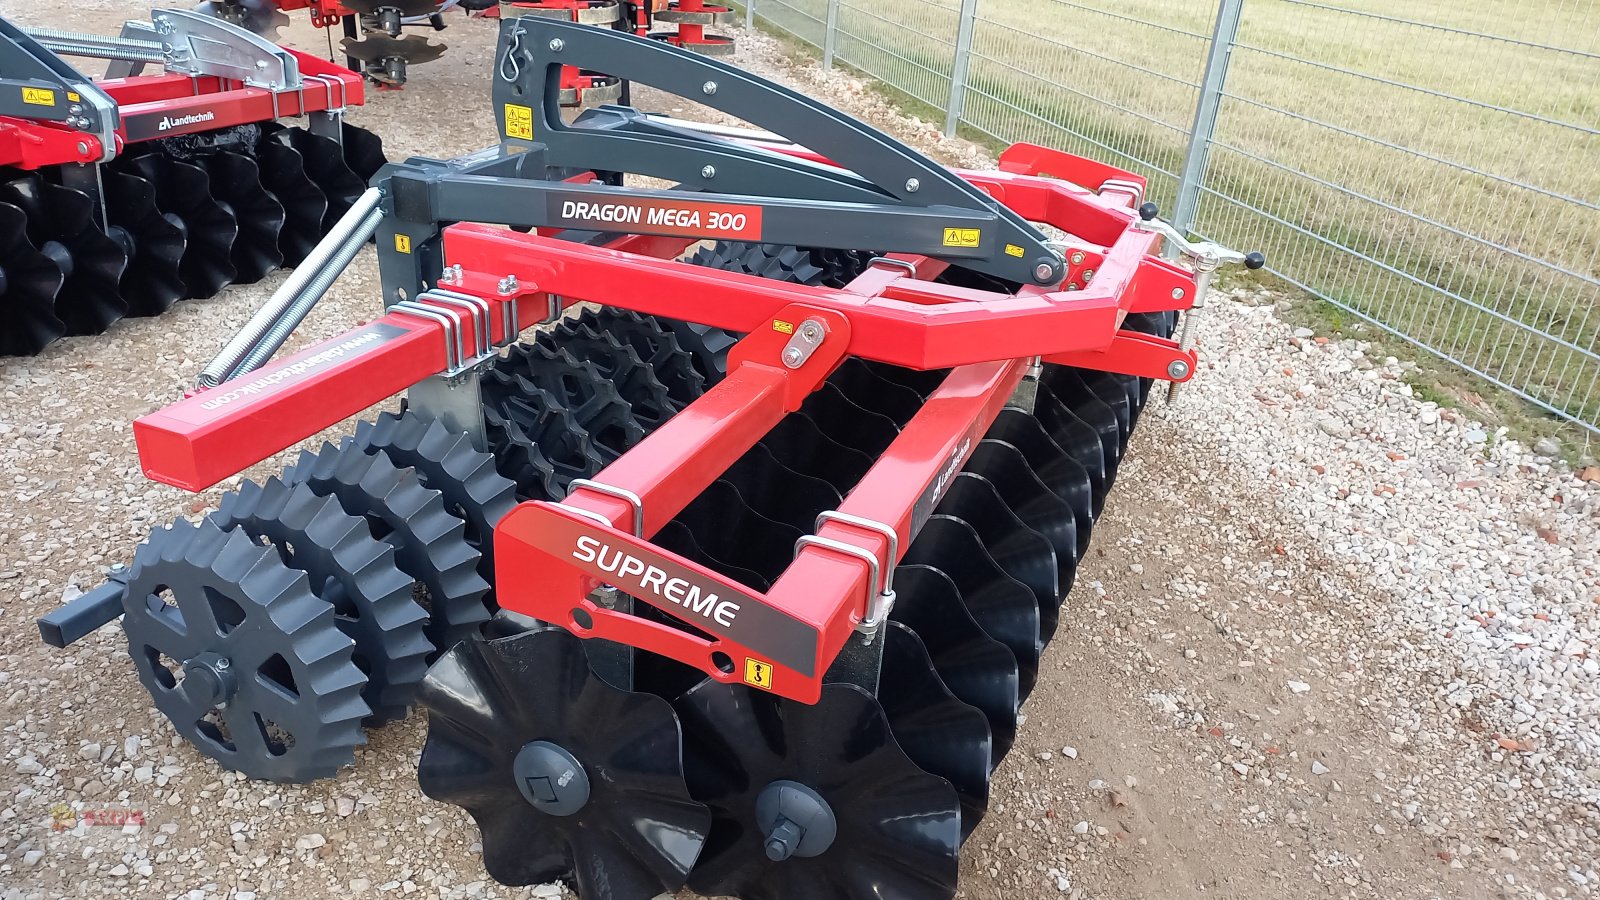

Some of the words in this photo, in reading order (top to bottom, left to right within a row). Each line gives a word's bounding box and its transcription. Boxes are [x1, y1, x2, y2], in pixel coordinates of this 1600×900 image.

[170, 111, 215, 126] Landtechnik
[561, 201, 641, 224] DRAGON
[647, 207, 701, 228] MEGA
[706, 211, 747, 231] 300
[200, 332, 382, 410] www.dalandtechnik.com
[572, 535, 741, 628] SUPREME
